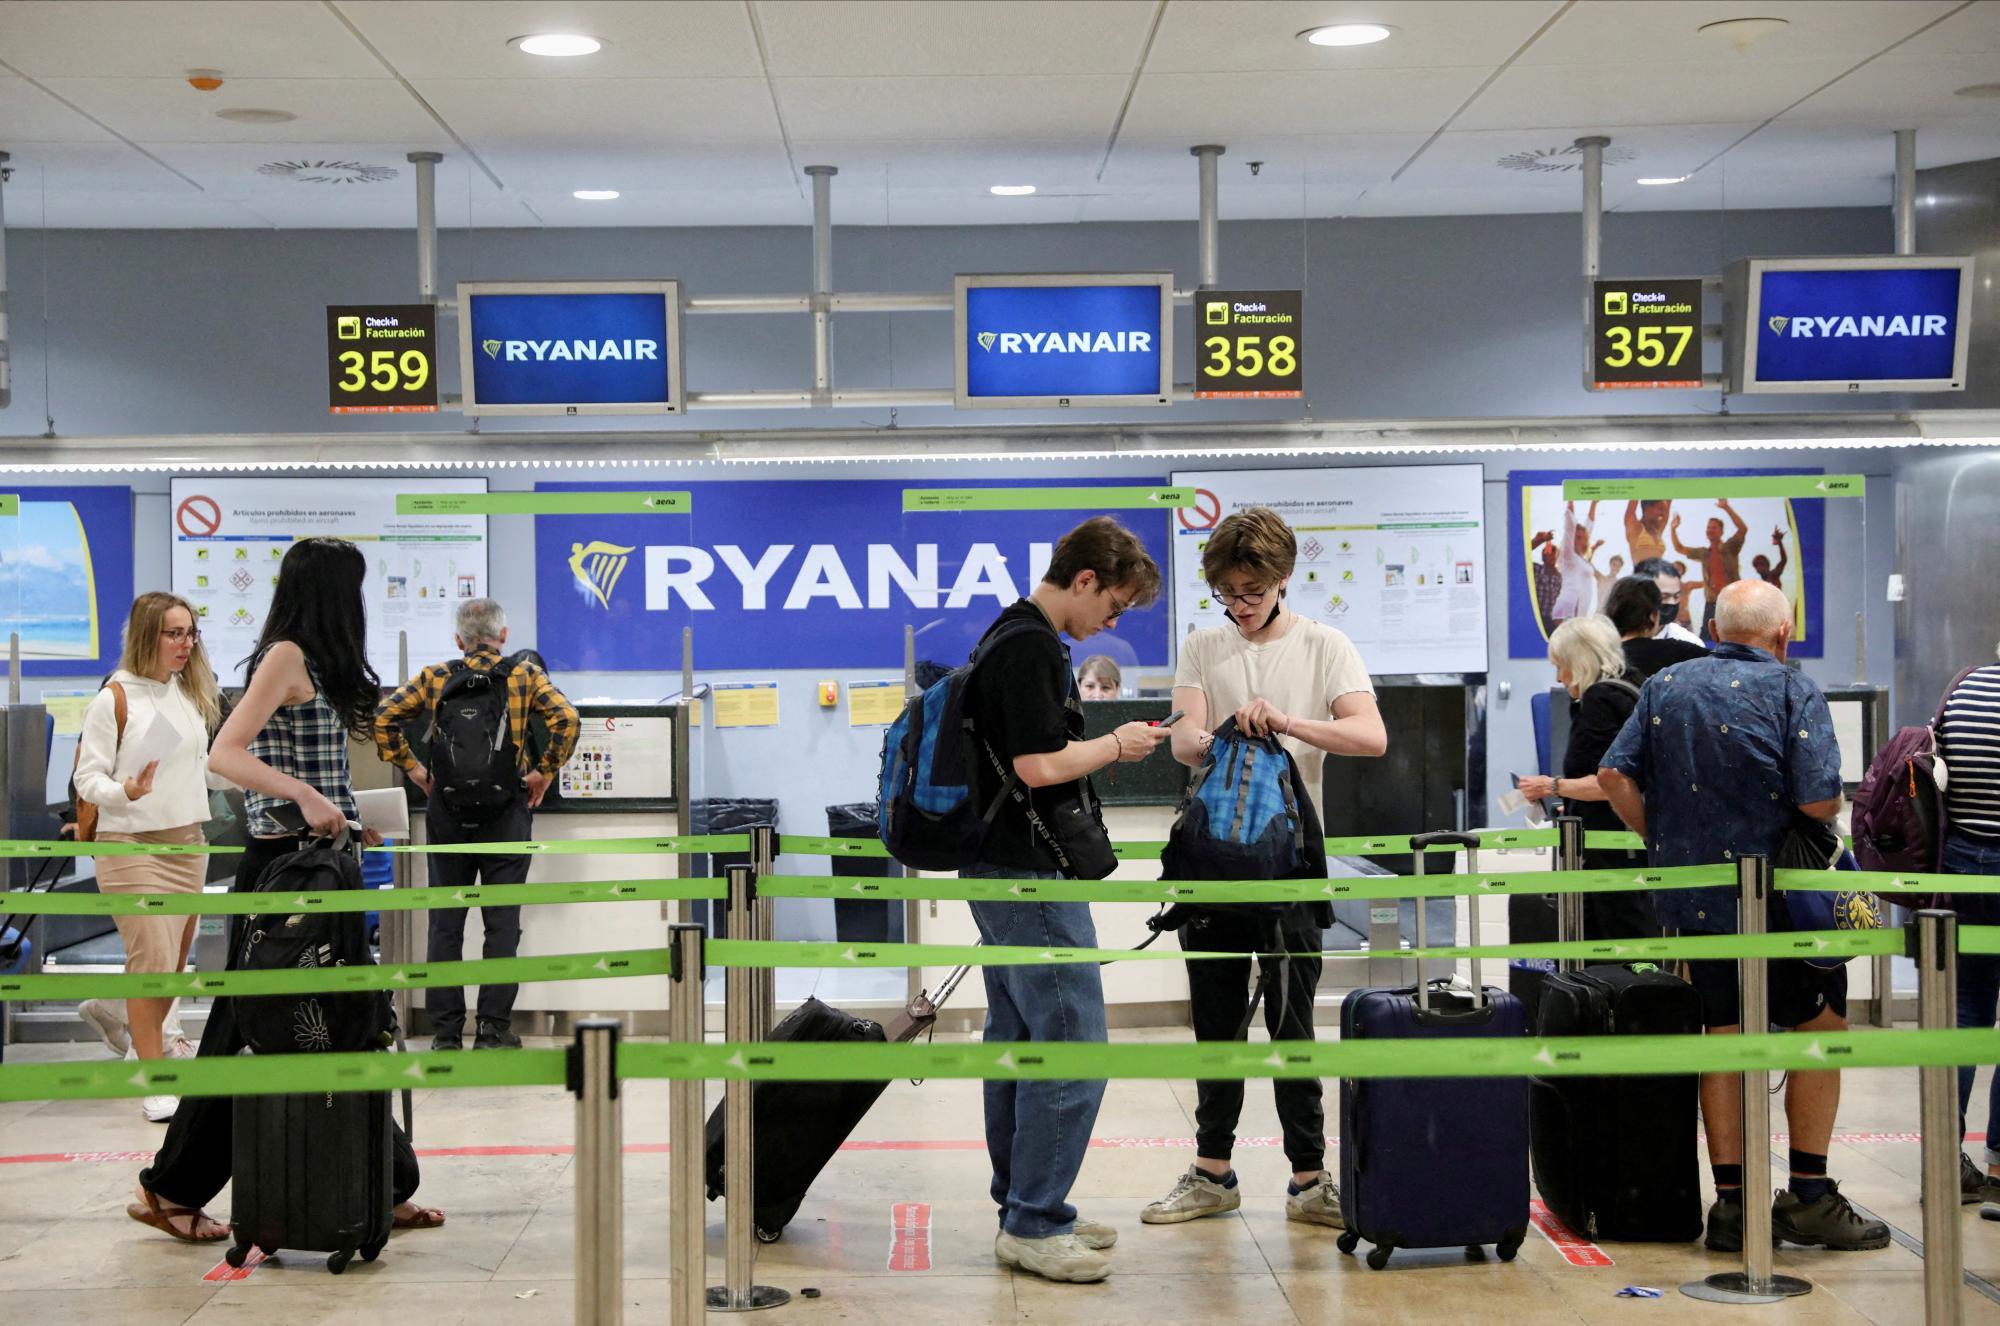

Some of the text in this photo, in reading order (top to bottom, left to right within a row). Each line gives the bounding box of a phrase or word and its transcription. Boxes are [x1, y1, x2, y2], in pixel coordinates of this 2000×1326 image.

[1233, 303, 1266, 312] Check-in
[1632, 293, 1665, 302] Check-in
[1233, 312, 1292, 324] Facturación
[1632, 302, 1691, 315] Facturación
[366, 317, 398, 327] Check-in
[366, 327, 425, 338] Facturación
[1791, 315, 1946, 338] RYANAIR
[505, 340, 658, 361] RYANAIR
[1000, 331, 1151, 353] RYANAIR
[1604, 326, 1693, 367] 357
[1203, 336, 1296, 377] 358
[338, 350, 429, 392] 359
[645, 543, 1053, 611] RYANAI
